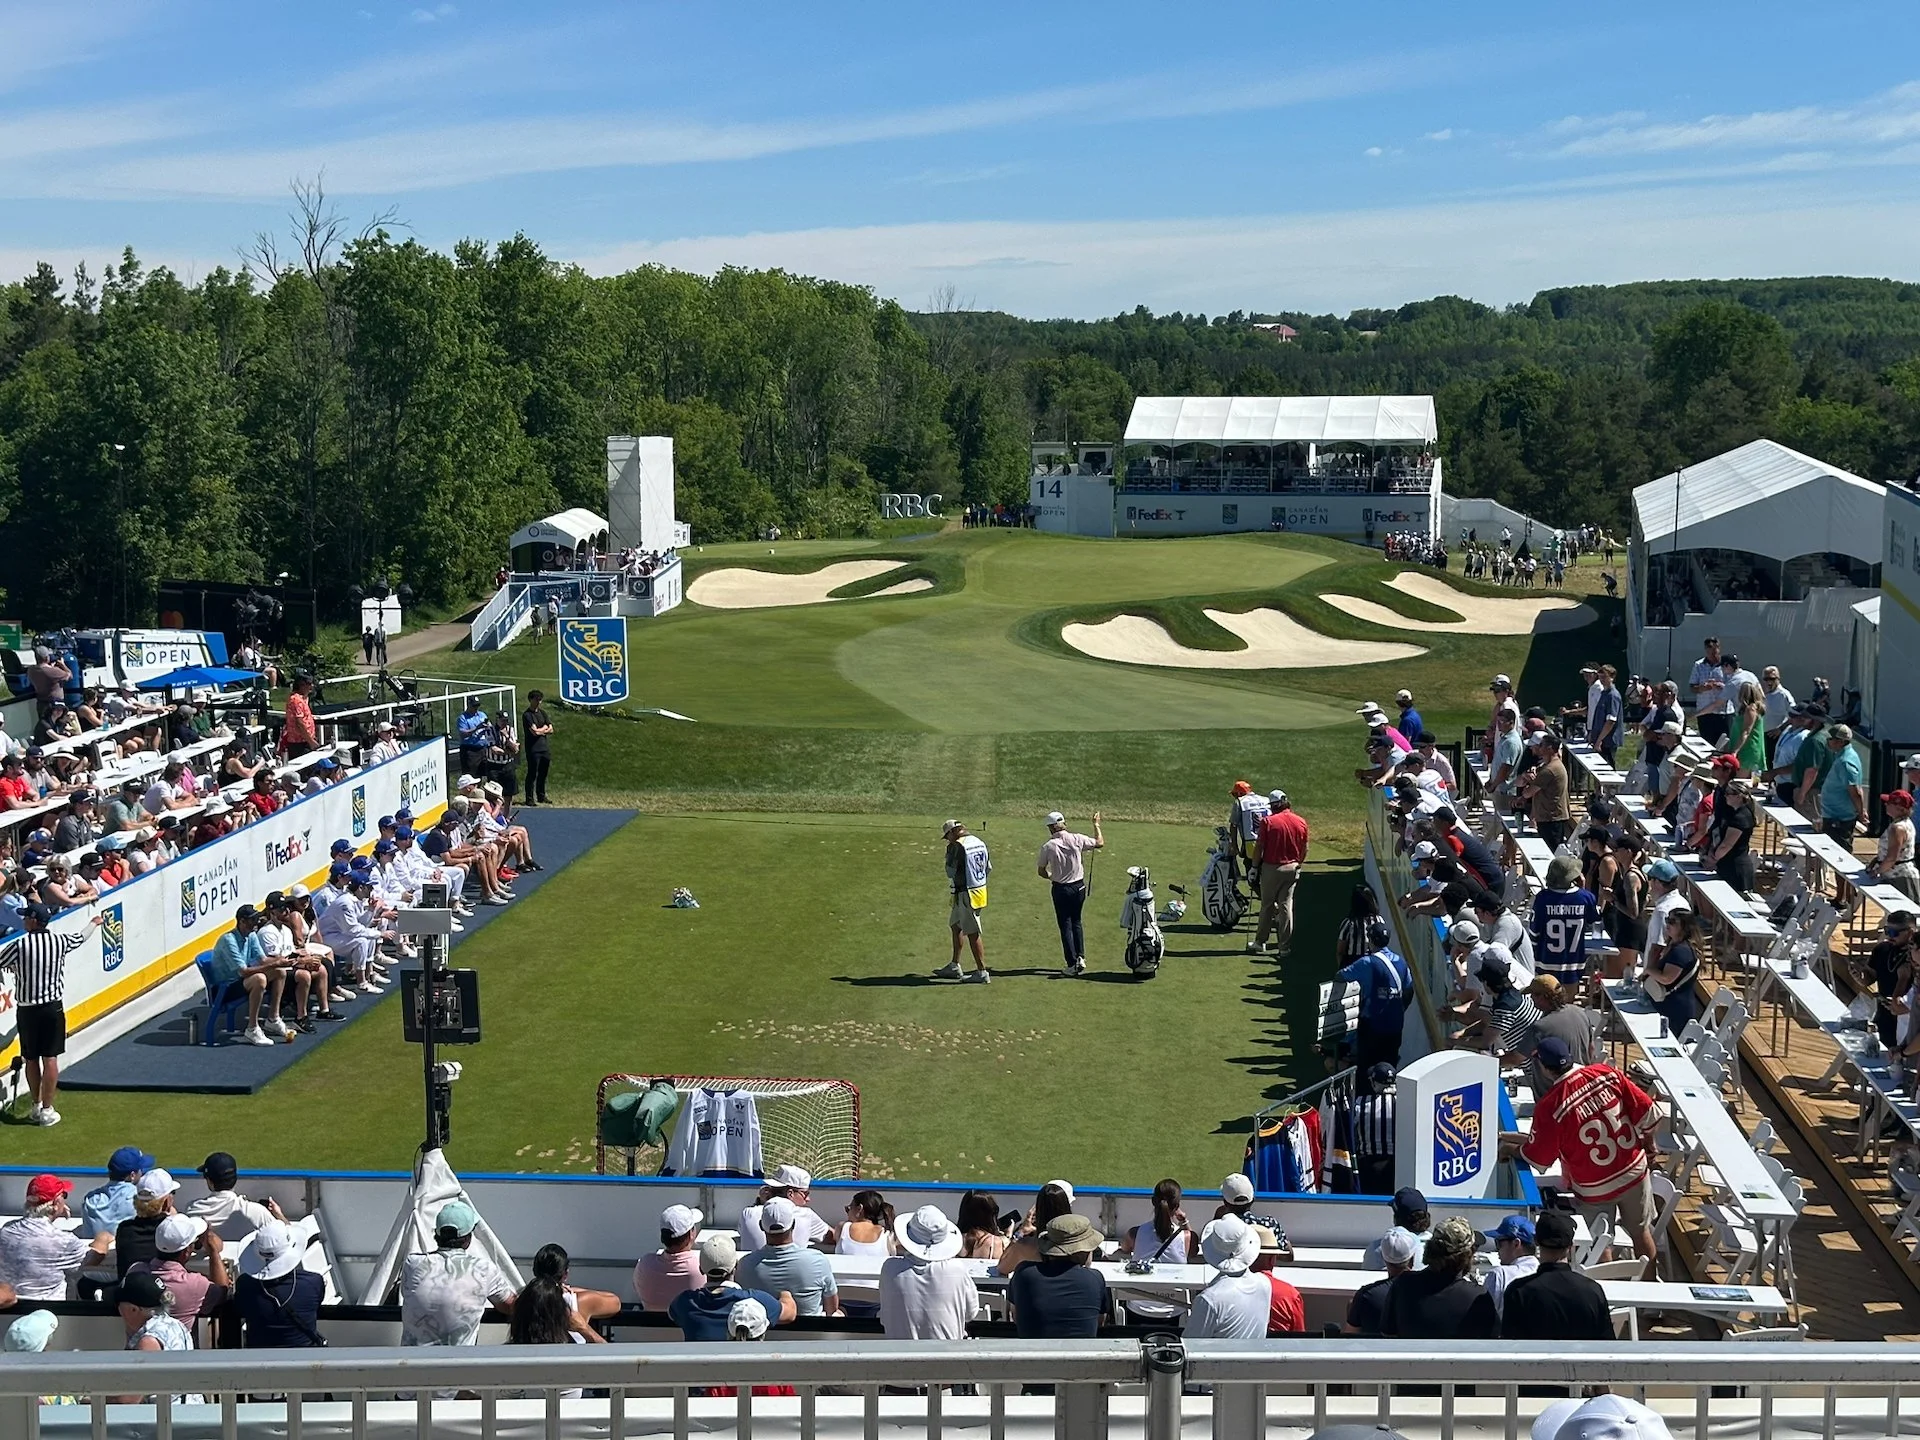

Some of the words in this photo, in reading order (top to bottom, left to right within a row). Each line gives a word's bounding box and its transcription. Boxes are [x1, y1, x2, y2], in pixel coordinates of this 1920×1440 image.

[1036, 479, 1063, 498] 14
[880, 493, 943, 518] RBC
[1138, 508, 1172, 521] FedEx
[1288, 505, 1329, 513] CANADIAN
[1288, 514, 1329, 525] OPEN
[1374, 510, 1410, 522] FedEx
[145, 648, 191, 664] OPEN
[568, 678, 622, 698] RBC
[410, 758, 437, 779] CANADIAN
[411, 774, 437, 803] OPEN
[354, 818, 366, 833] RBC
[275, 835, 302, 868] FedEx
[198, 854, 238, 886] CANADIAN
[198, 875, 238, 916] OPEN
[182, 909, 196, 926] RBC
[1546, 918, 1585, 953] 97
[104, 949, 123, 970] RBC
[711, 1126, 744, 1138] OPEN
[1579, 1100, 1637, 1166] 35
[1438, 1151, 1478, 1182] RBC
